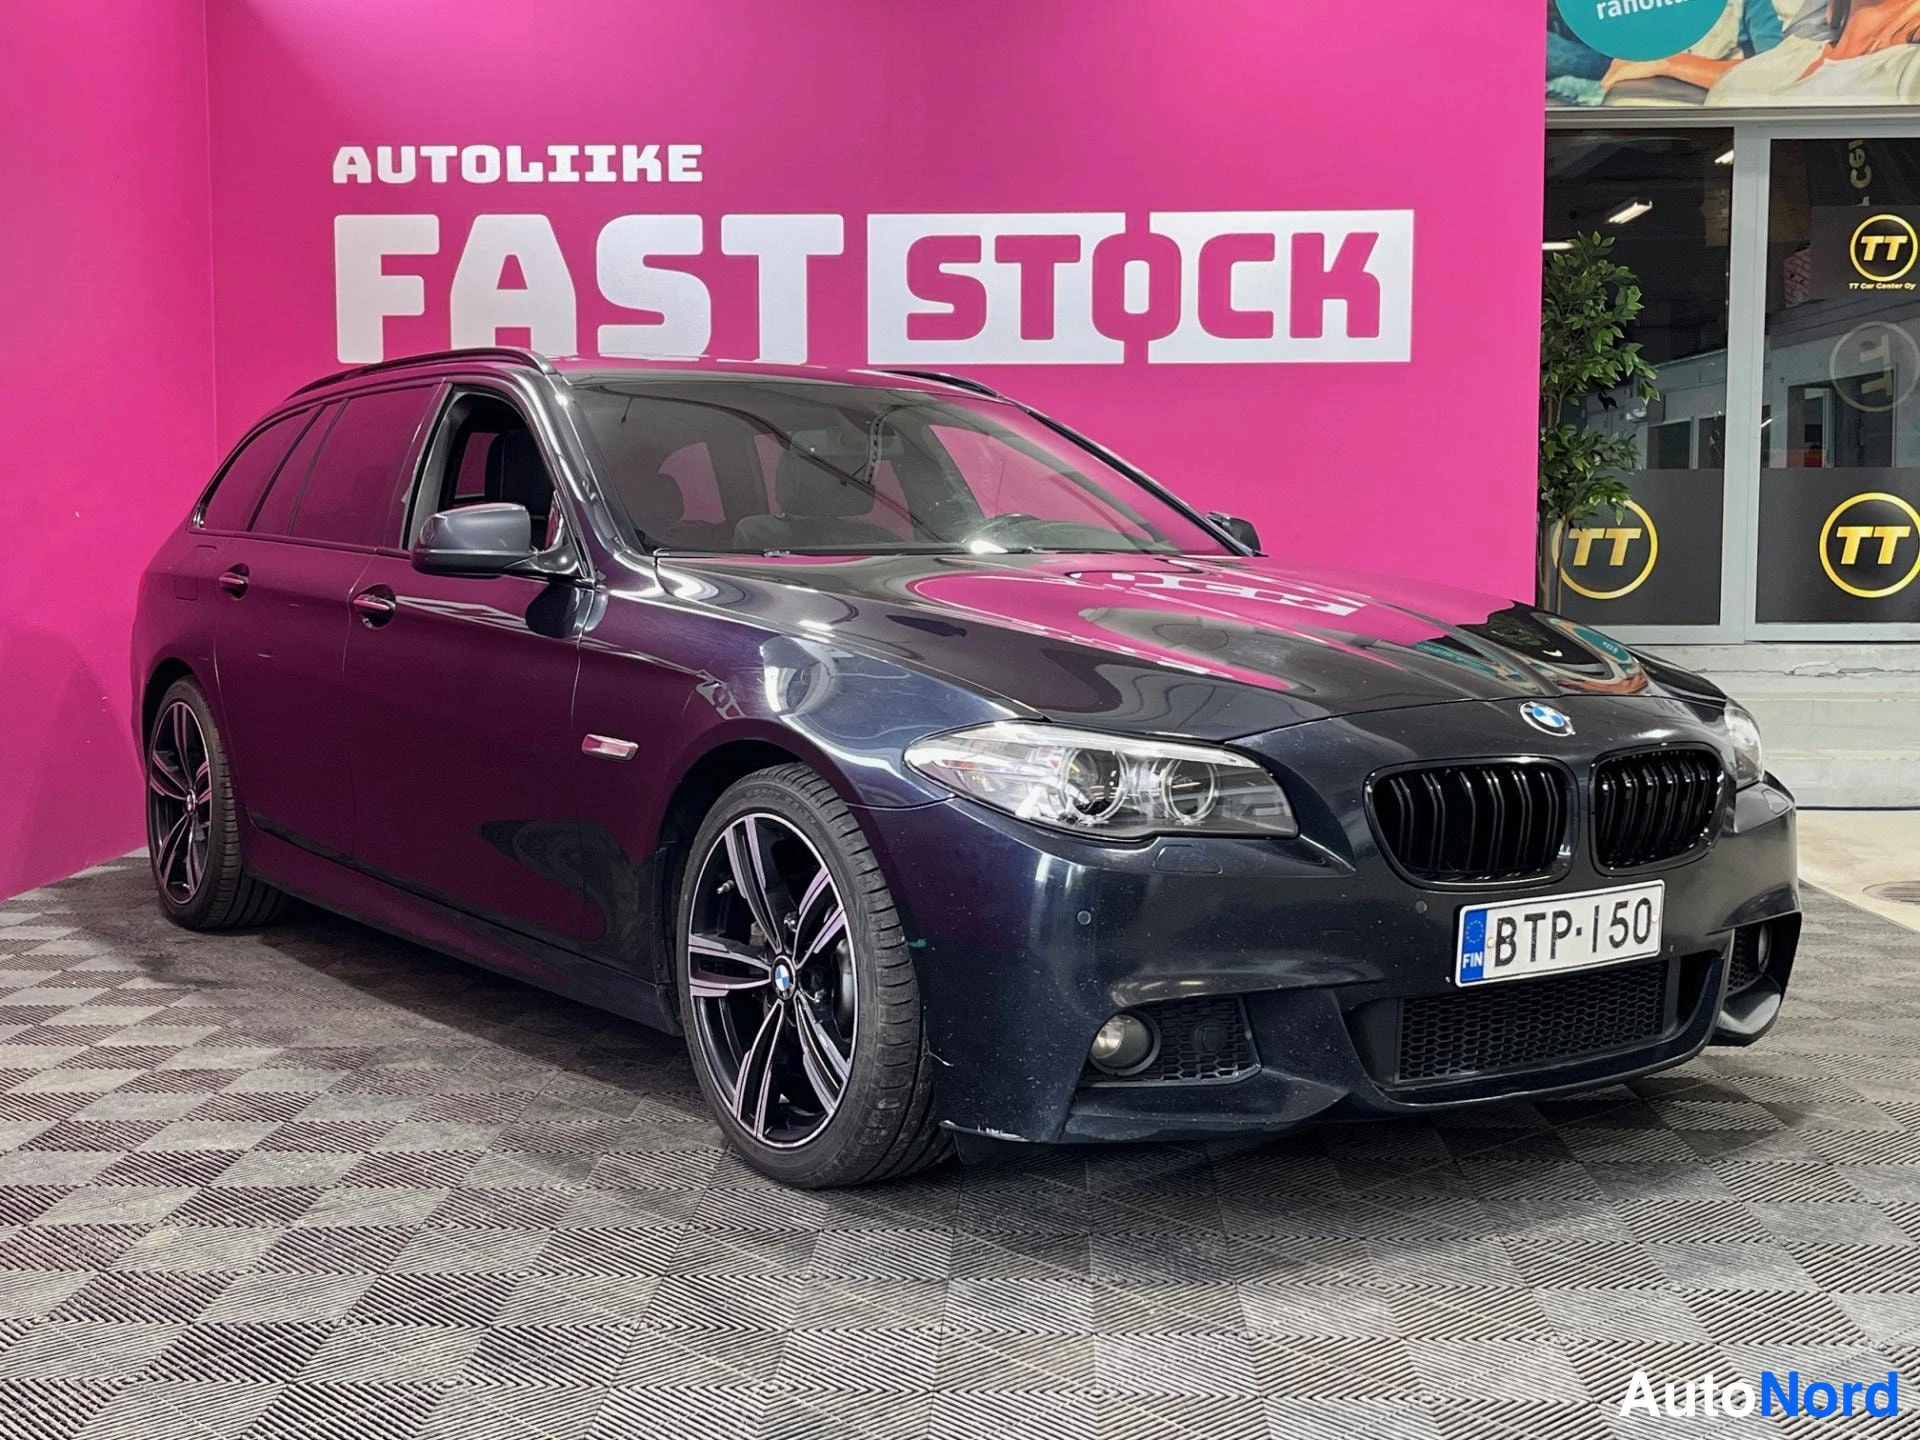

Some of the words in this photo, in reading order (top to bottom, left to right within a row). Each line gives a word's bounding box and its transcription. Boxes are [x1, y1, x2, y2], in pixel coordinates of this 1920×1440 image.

[332, 144, 703, 184] AUTOLIIKE
[1861, 235, 1908, 261] TT
[333, 214, 844, 364] FAST
[906, 231, 1381, 342] STOCK
[1904, 282, 1916, 290] Oy
[1568, 528, 1641, 566] TT
[1836, 526, 1911, 565] TT
[1462, 951, 1483, 969] FIN
